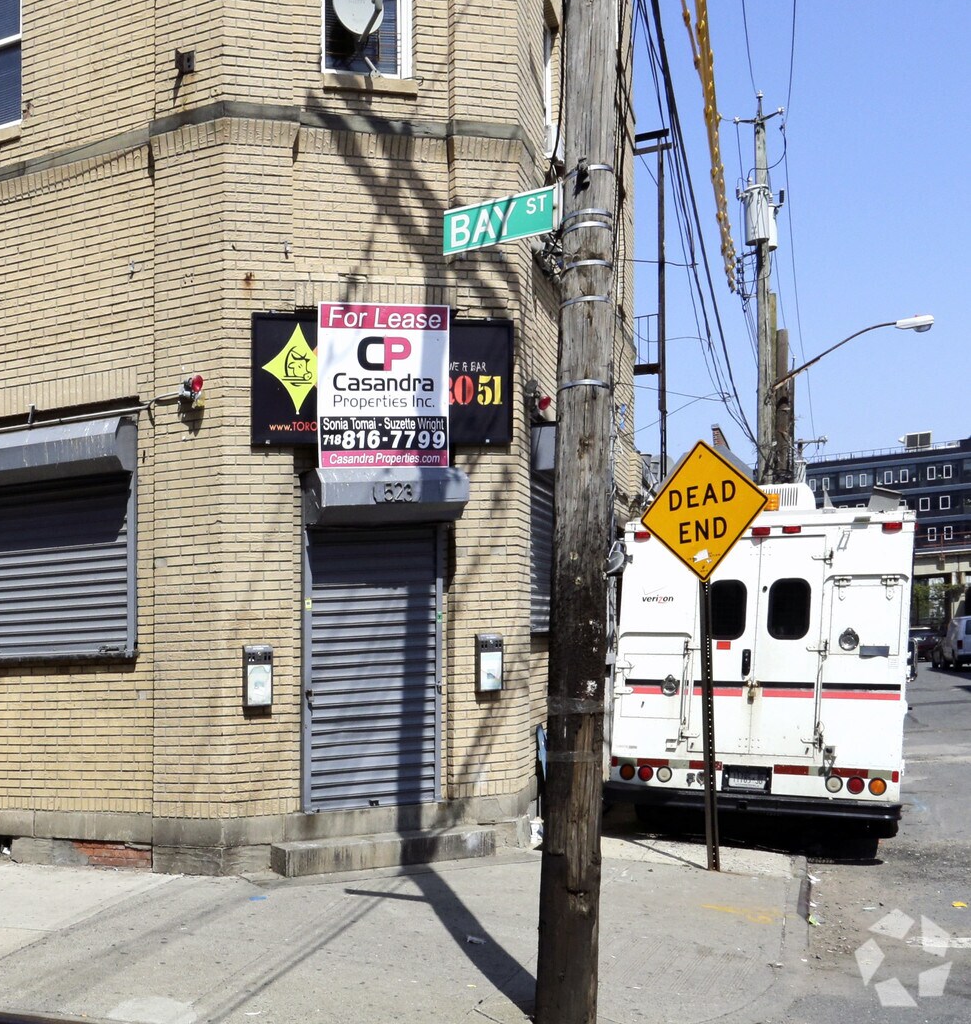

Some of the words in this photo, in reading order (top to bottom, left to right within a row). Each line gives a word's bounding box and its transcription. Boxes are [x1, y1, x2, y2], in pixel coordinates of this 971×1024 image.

[450, 201, 517, 248] BAY
[526, 194, 547, 215] ST
[328, 306, 368, 327] For
[374, 307, 442, 329] Lease
[357, 336, 412, 371] CP
[470, 361, 487, 372] BAR
[332, 372, 435, 392] Casandra
[477, 375, 503, 405] 51
[333, 394, 408, 410] Properties
[412, 394, 435, 408] Inc.
[323, 417, 349, 431] Sonia
[350, 416, 376, 430] Tomai
[384, 417, 416, 430] Suzette
[417, 418, 444, 432] Wright
[323, 434, 342, 446] 718
[341, 430, 446, 449] 816-7799
[384, 482, 414, 502] 523
[669, 480, 736, 511] DEAD
[679, 516, 728, 544] END
[642, 594, 674, 604] verizon
